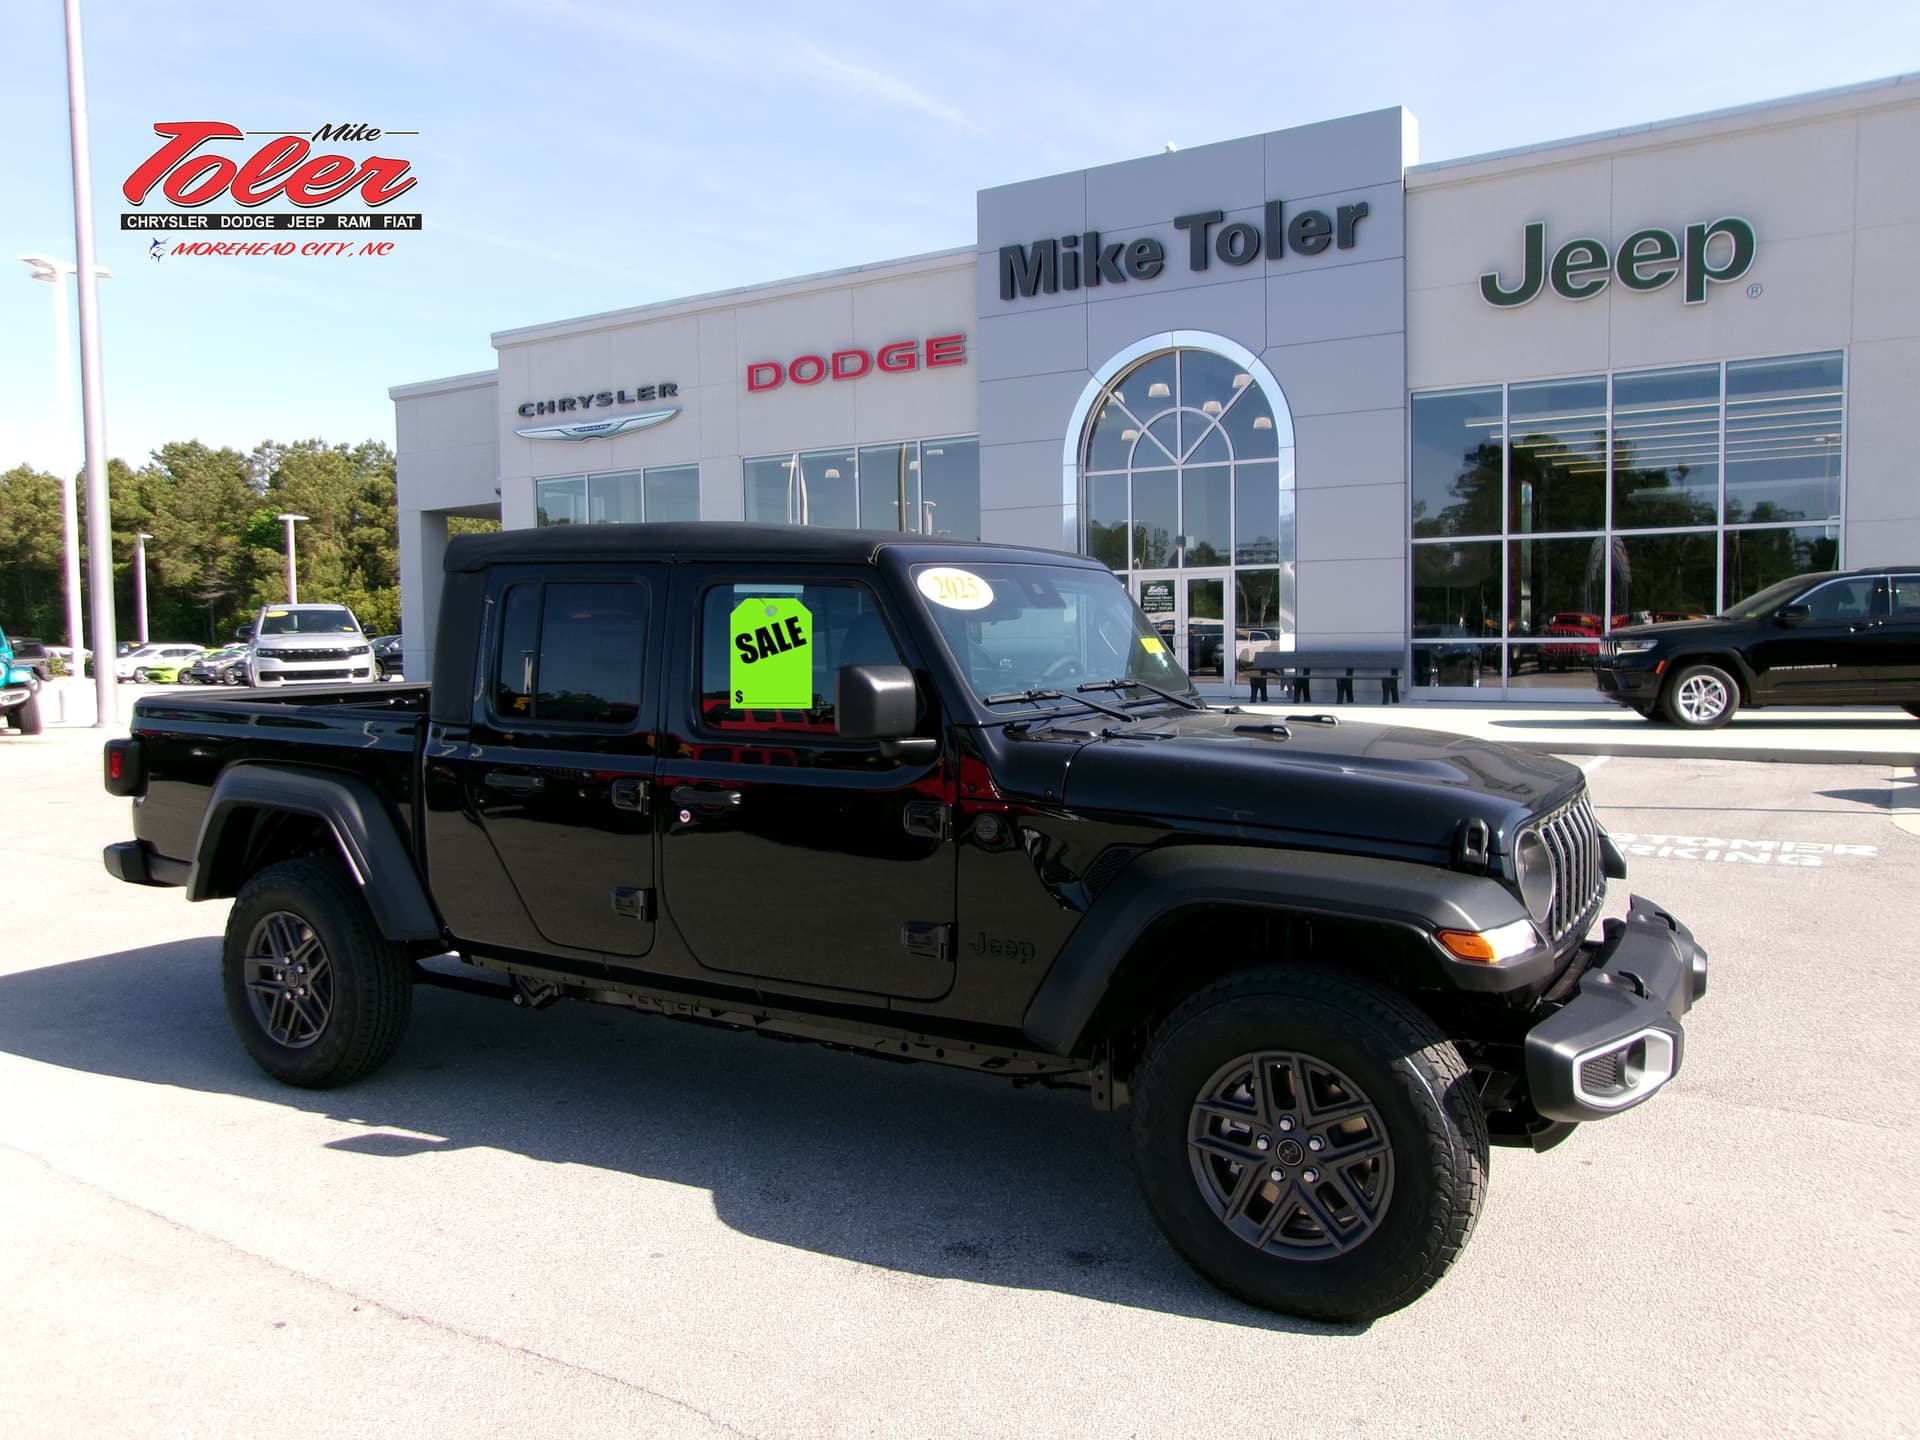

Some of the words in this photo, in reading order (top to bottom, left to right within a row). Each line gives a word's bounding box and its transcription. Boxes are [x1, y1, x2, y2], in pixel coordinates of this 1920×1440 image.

[999, 230, 1165, 301] Mike
[1174, 199, 1369, 272] Toler
[1479, 216, 1756, 309] Jeep
[747, 331, 967, 393] DODGE
[518, 382, 680, 419] CHRYSLER
[933, 575, 980, 599] 2025
[735, 616, 807, 664] SALE
[735, 689, 744, 704] $
[1607, 832, 1879, 856] STOMER
[968, 931, 1036, 964] Jeep
